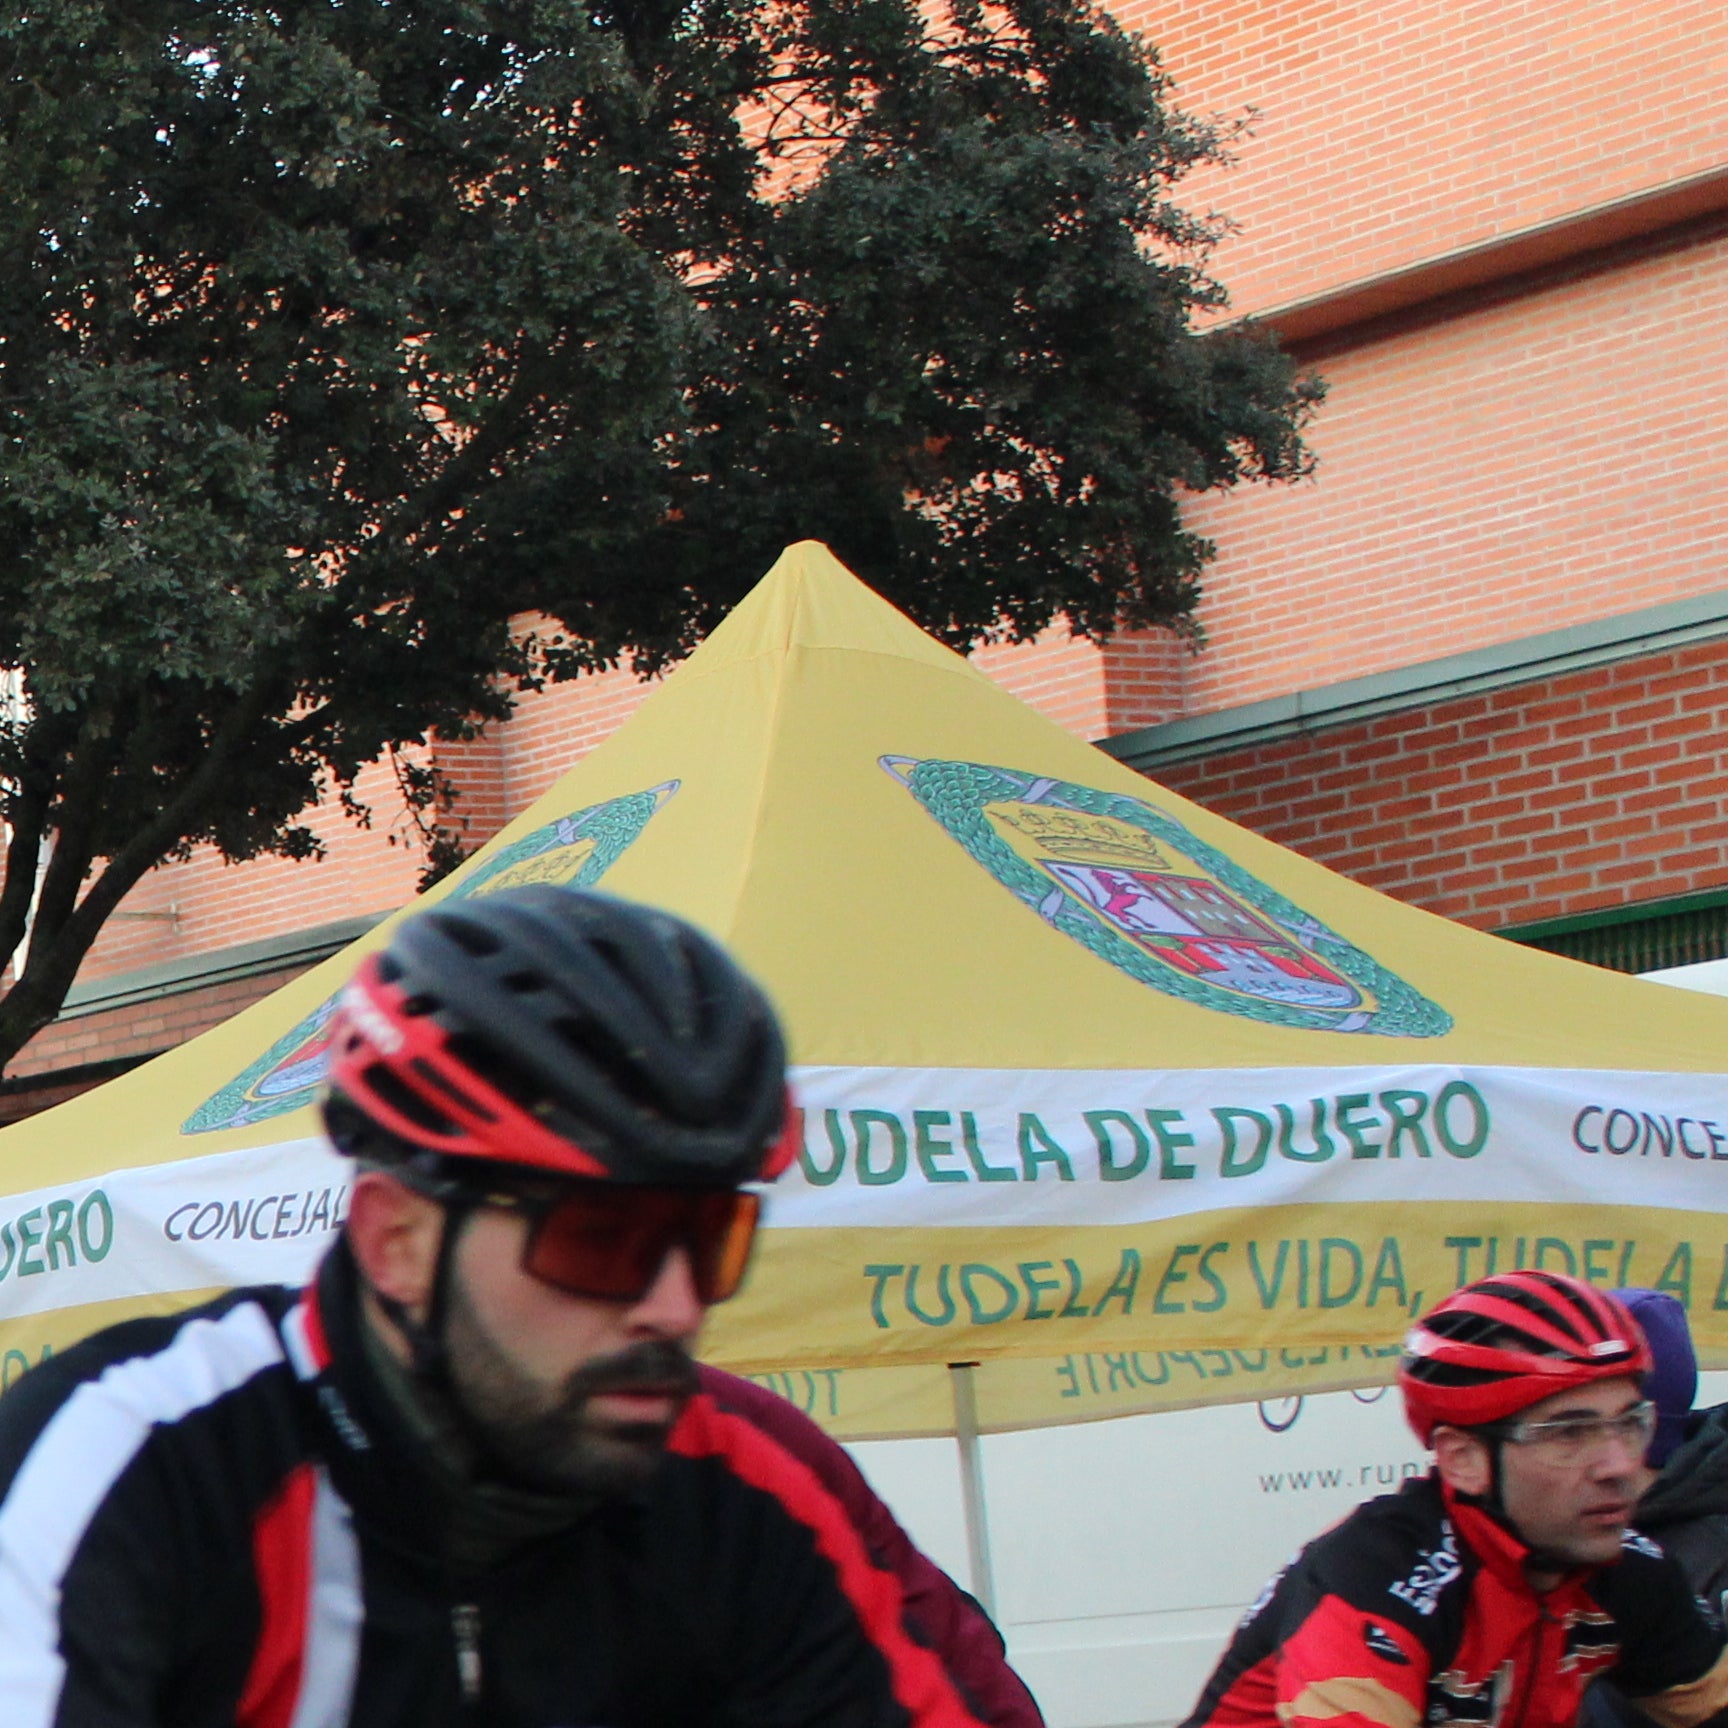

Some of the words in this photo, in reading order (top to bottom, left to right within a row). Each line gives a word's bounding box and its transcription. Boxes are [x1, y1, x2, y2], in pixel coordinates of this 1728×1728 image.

[796, 1107, 1075, 1189] UDELA
[1084, 1105, 1196, 1181] DE
[1210, 1079, 1491, 1180] DUERO
[862, 1248, 1141, 1333] TUDELA
[1152, 1240, 1229, 1316] ES
